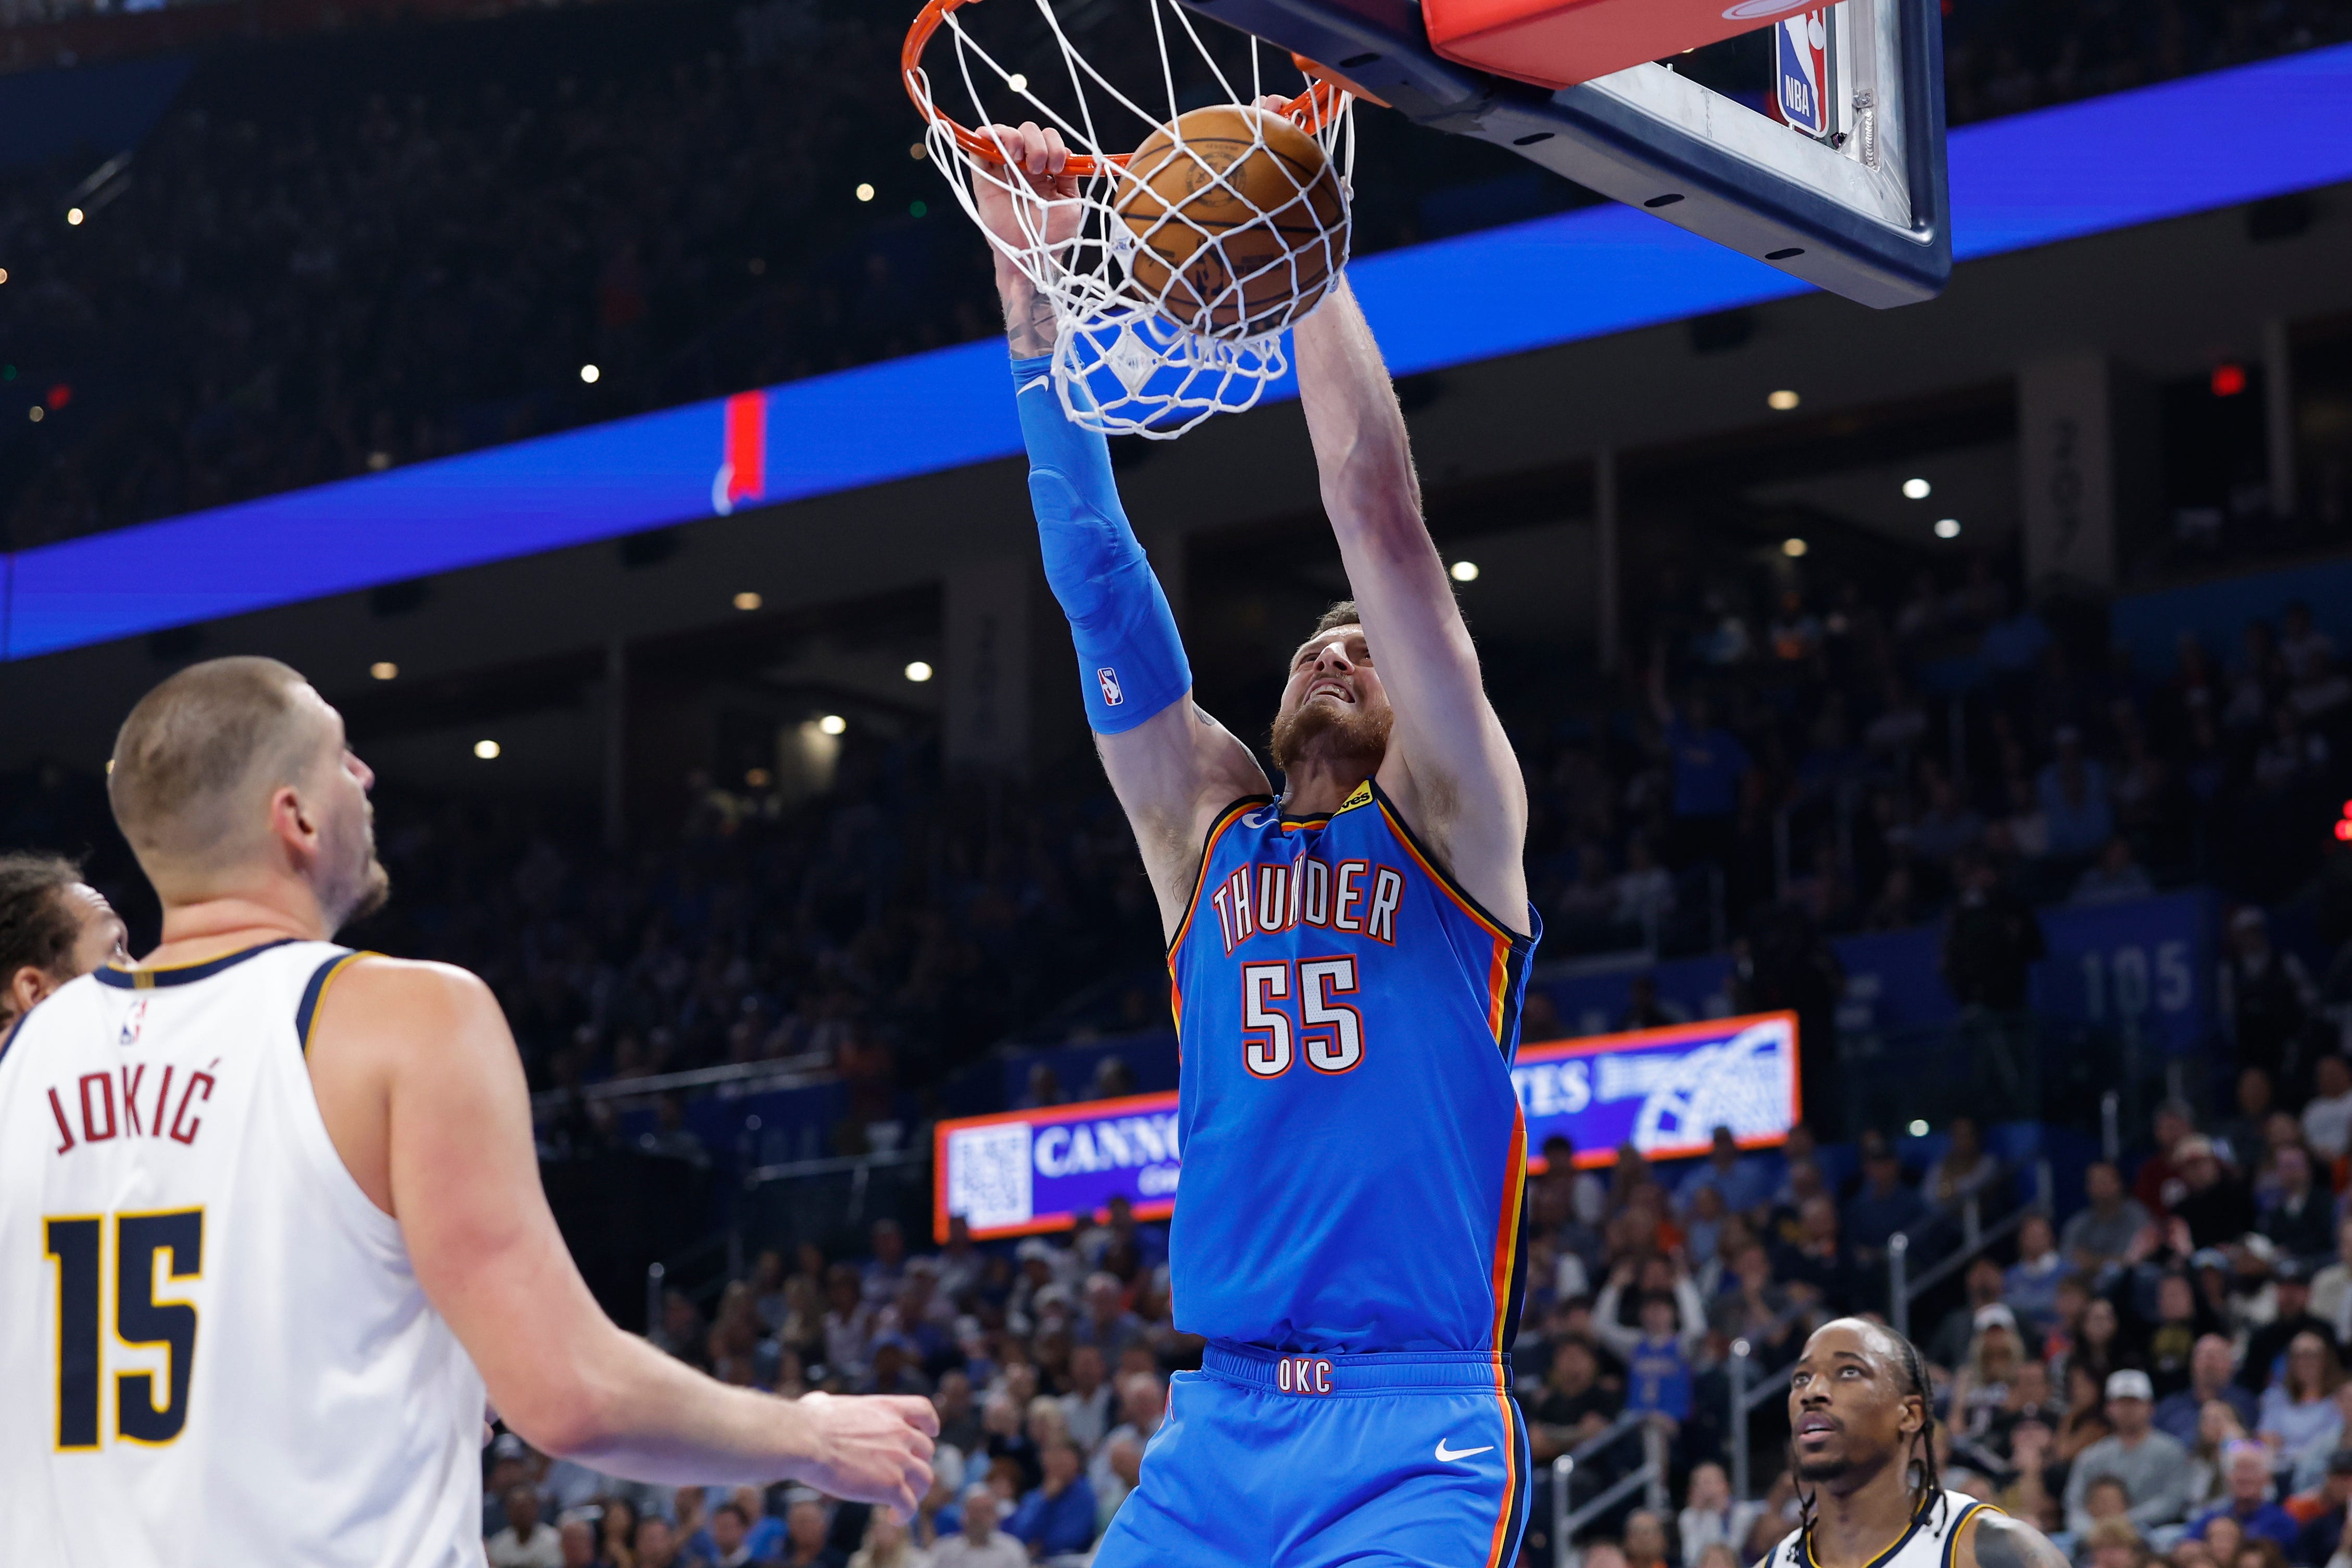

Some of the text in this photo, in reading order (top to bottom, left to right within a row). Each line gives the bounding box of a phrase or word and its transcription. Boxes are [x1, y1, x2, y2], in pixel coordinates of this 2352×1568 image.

[1785, 74, 1810, 117] NBA
[1212, 849, 1406, 958] THUNDER
[1241, 953, 1366, 1080] 55
[2082, 938, 2192, 1021] 105
[47, 1057, 221, 1156] JOKIĆ
[43, 1204, 205, 1452] 15
[1278, 1356, 1332, 1395] OKC
